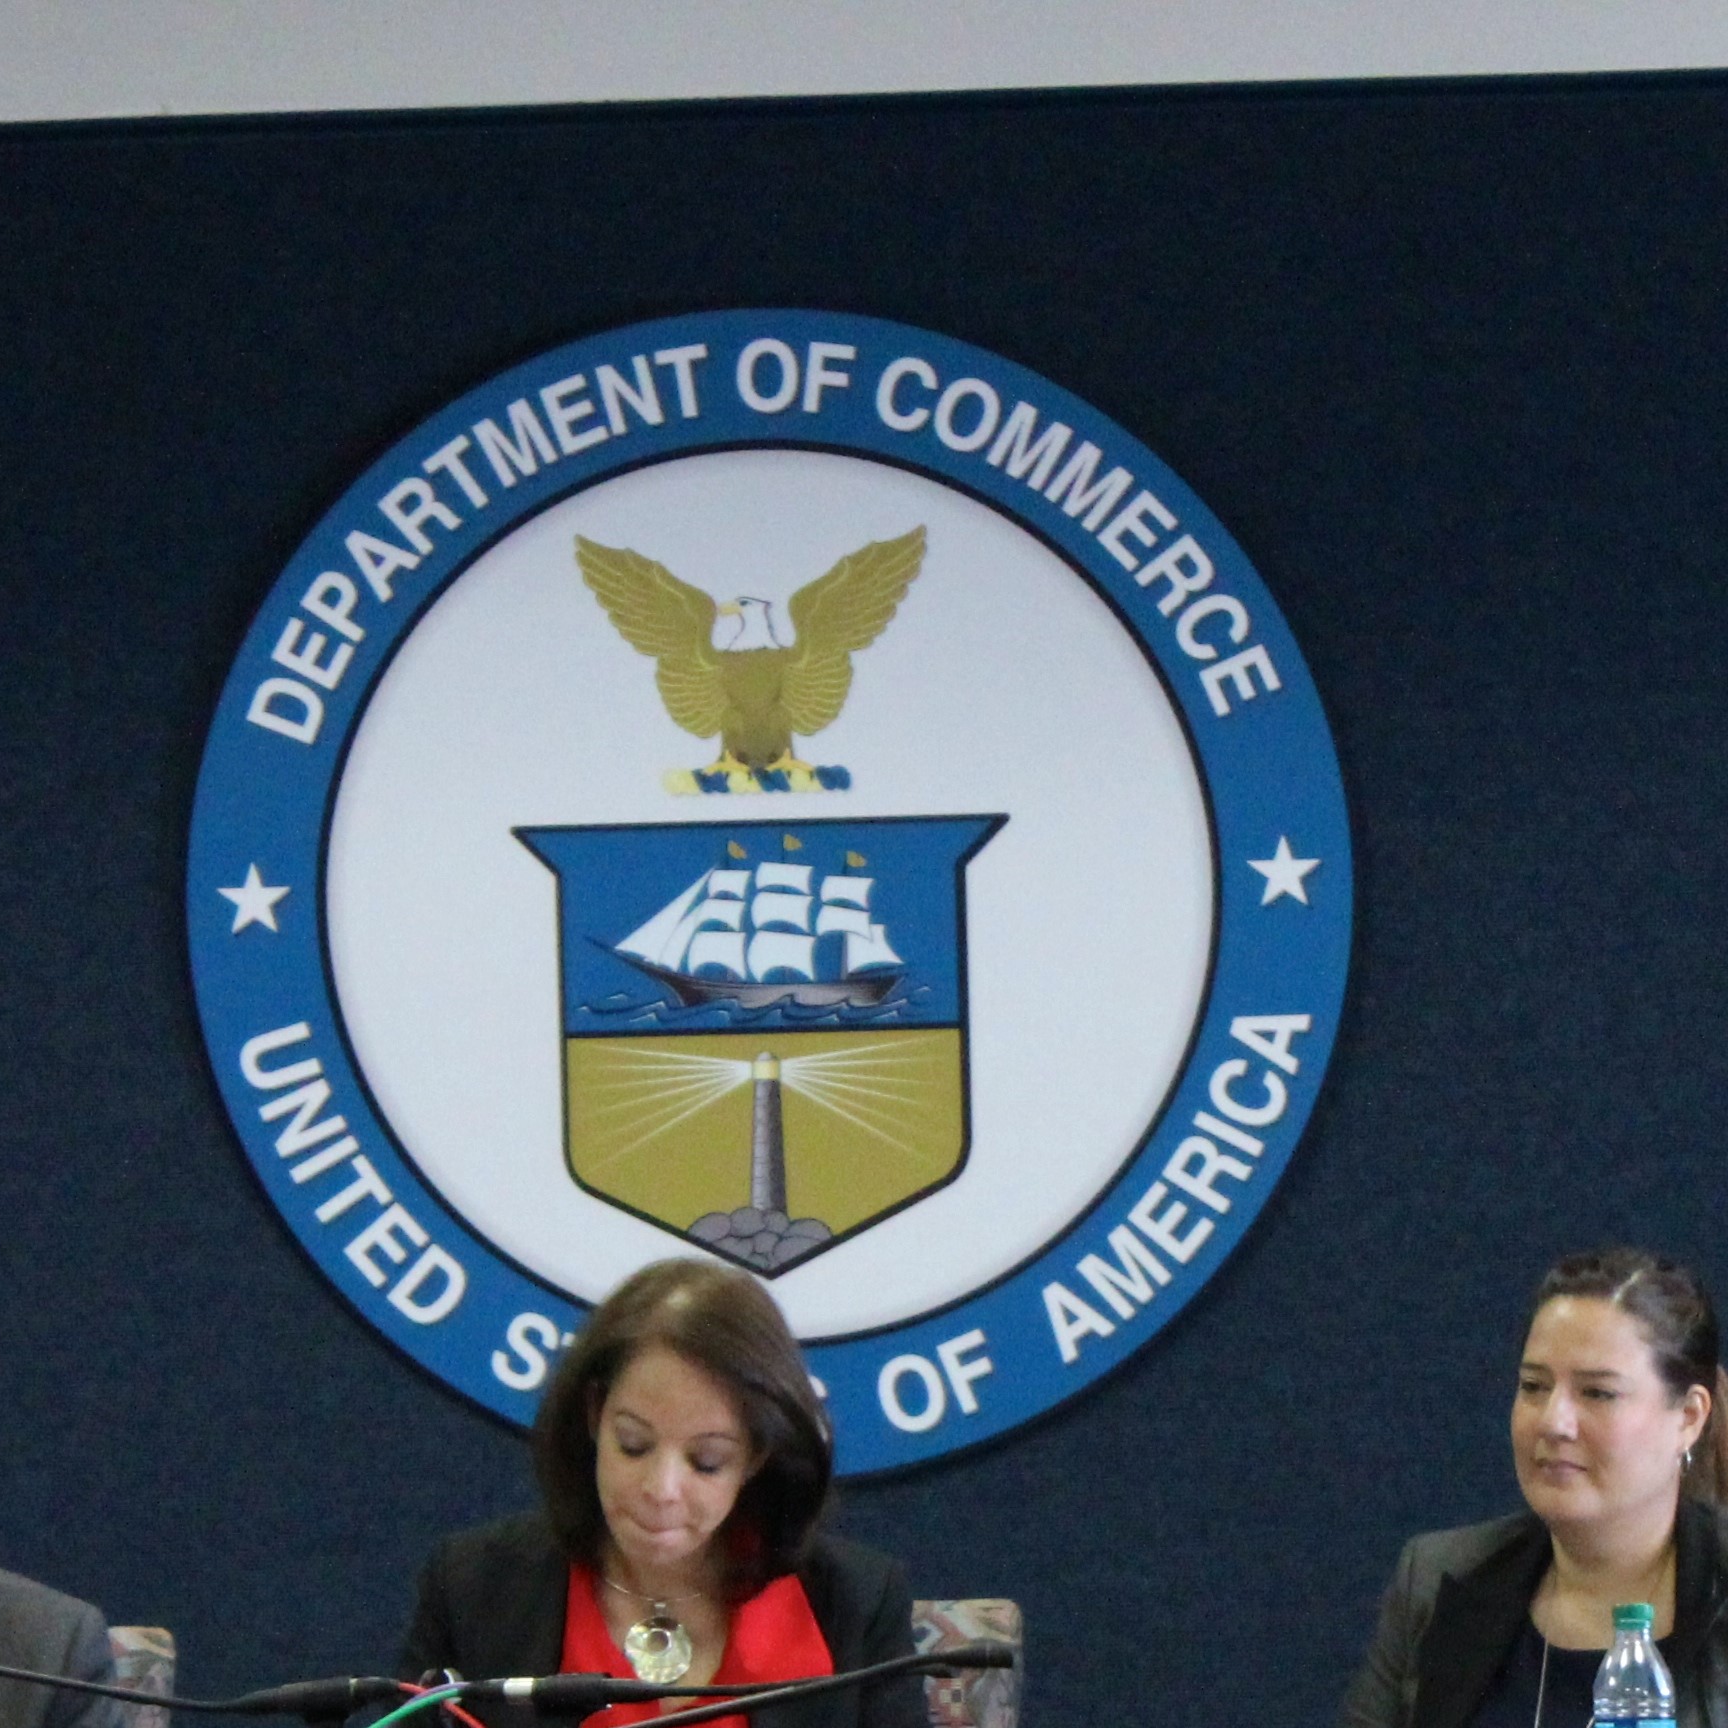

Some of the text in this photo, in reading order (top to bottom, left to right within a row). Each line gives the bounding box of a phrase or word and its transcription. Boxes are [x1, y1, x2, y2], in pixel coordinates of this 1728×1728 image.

[246, 338, 1282, 745] DEPARTMENT OF COMMERCE
[239, 1013, 1311, 1433] UNITED OF AMERICA
